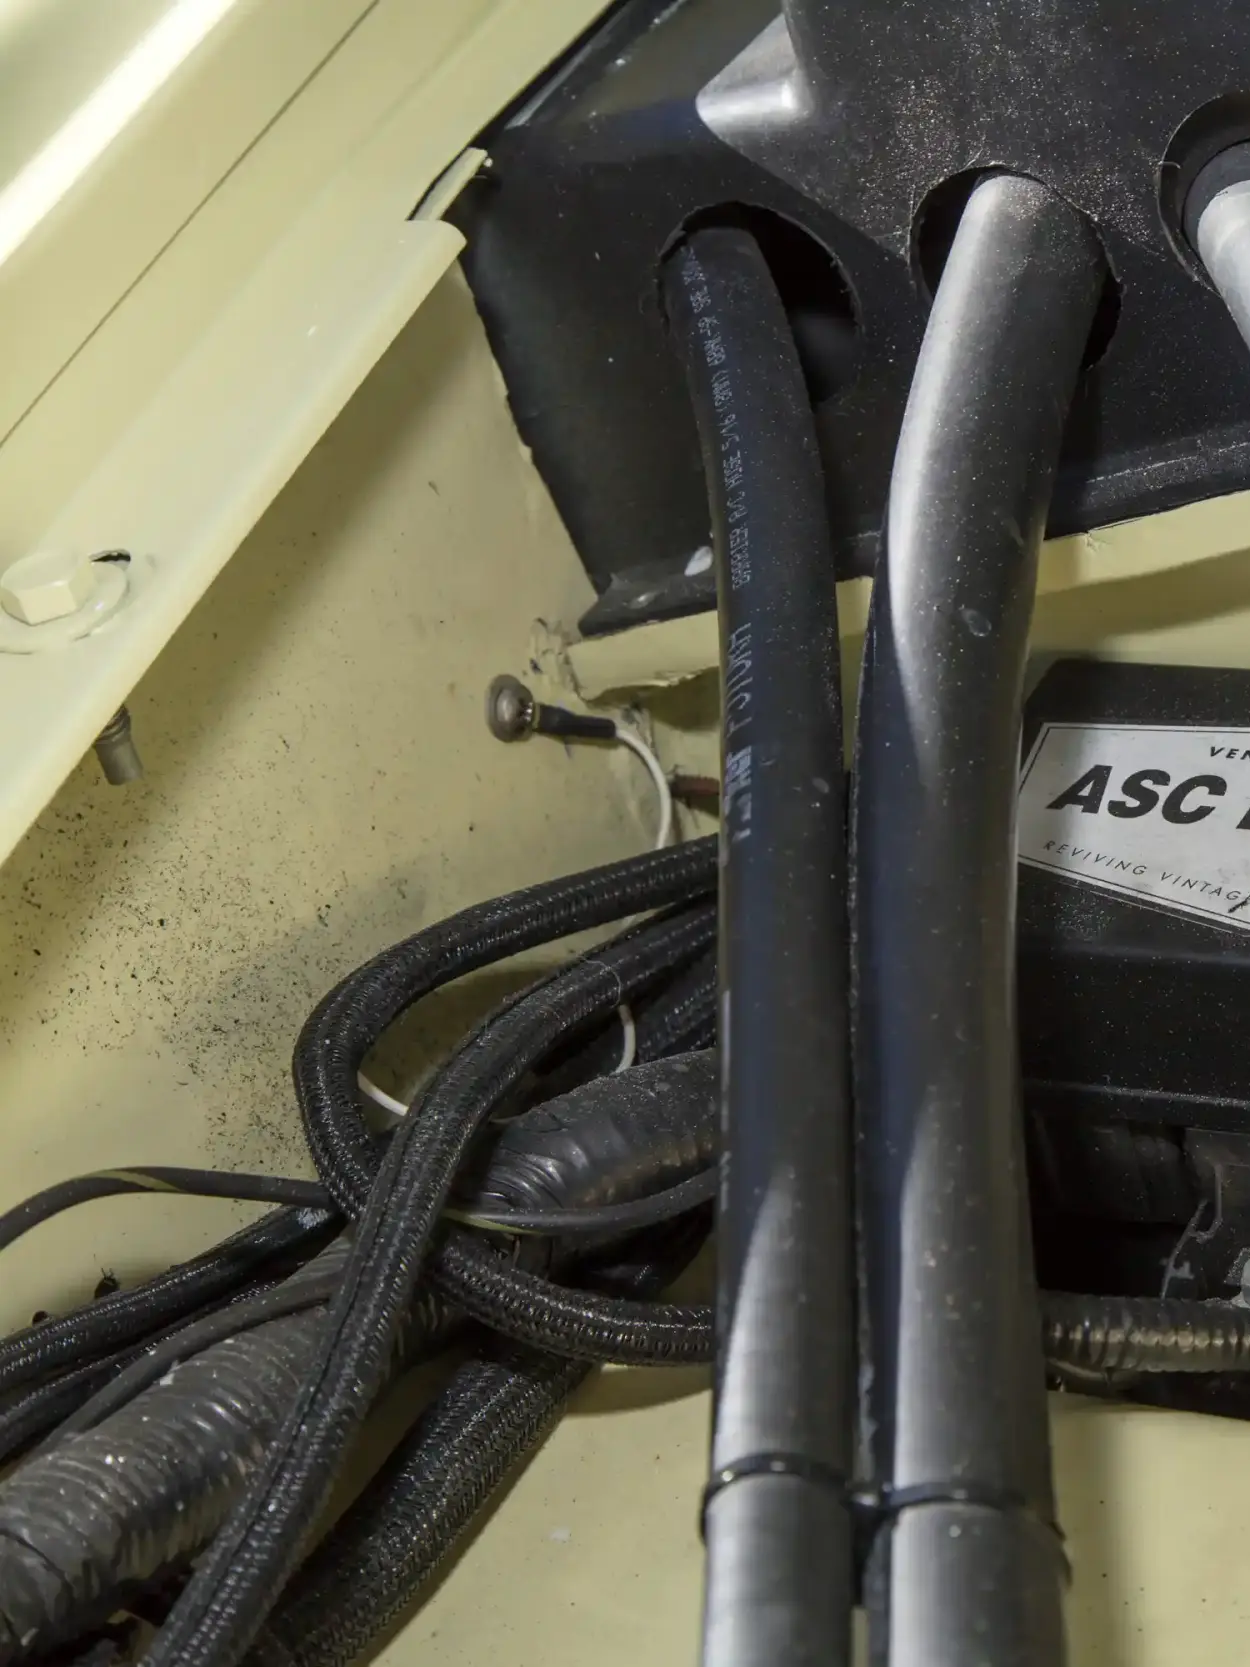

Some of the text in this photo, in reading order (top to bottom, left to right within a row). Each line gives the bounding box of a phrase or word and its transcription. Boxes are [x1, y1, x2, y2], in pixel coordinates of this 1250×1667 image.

[724, 450, 743, 491] HOSE
[729, 525, 750, 590] BARRIER
[1046, 764, 1228, 825] ASC
[1043, 840, 1148, 876] REVIVING
